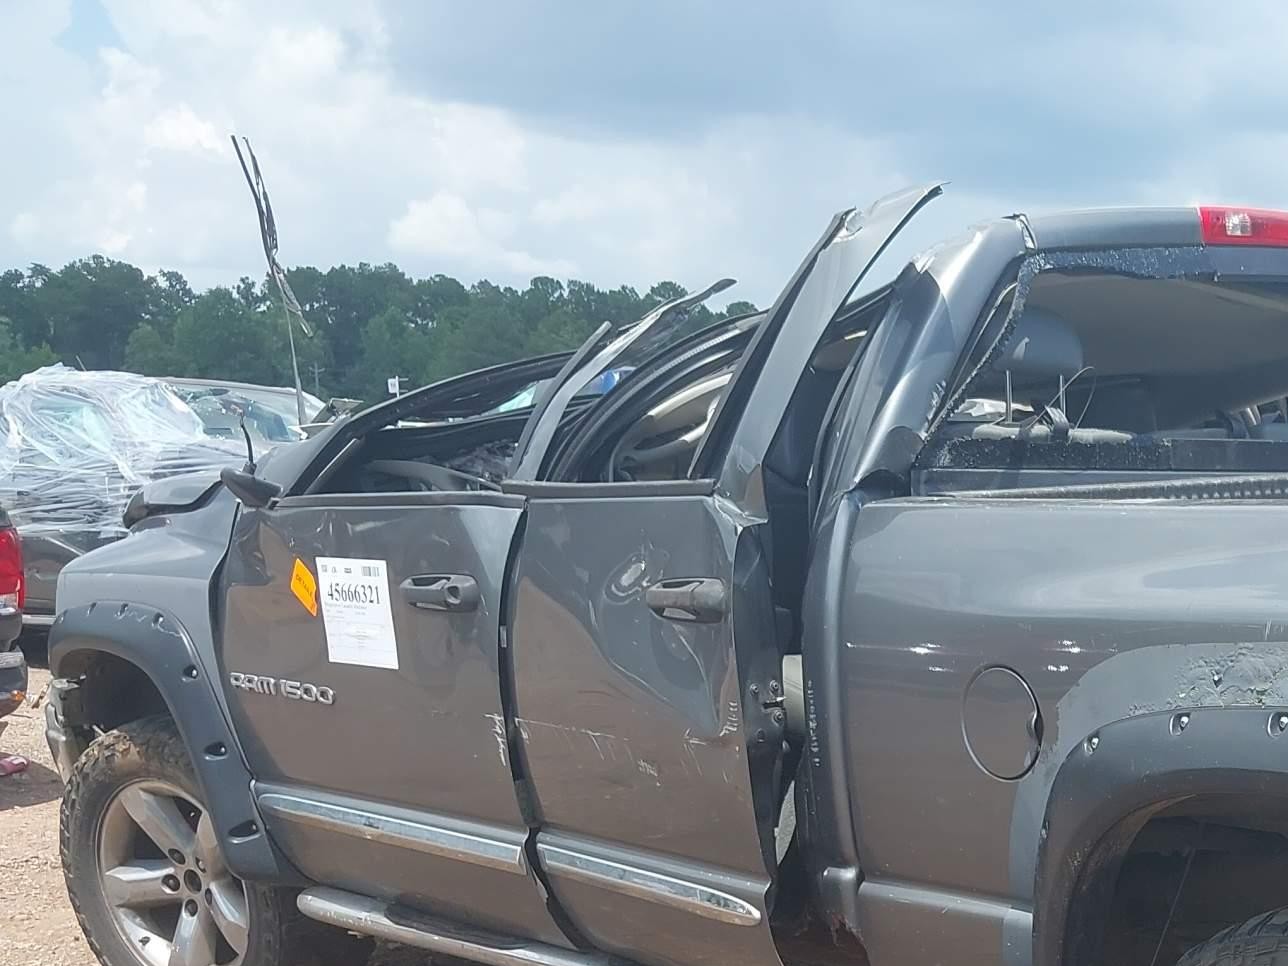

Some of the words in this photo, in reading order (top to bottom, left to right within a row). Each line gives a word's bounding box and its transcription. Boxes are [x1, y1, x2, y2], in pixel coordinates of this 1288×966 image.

[327, 581, 380, 605] 45666321
[230, 672, 276, 696] RAM
[279, 678, 335, 705] 1500
